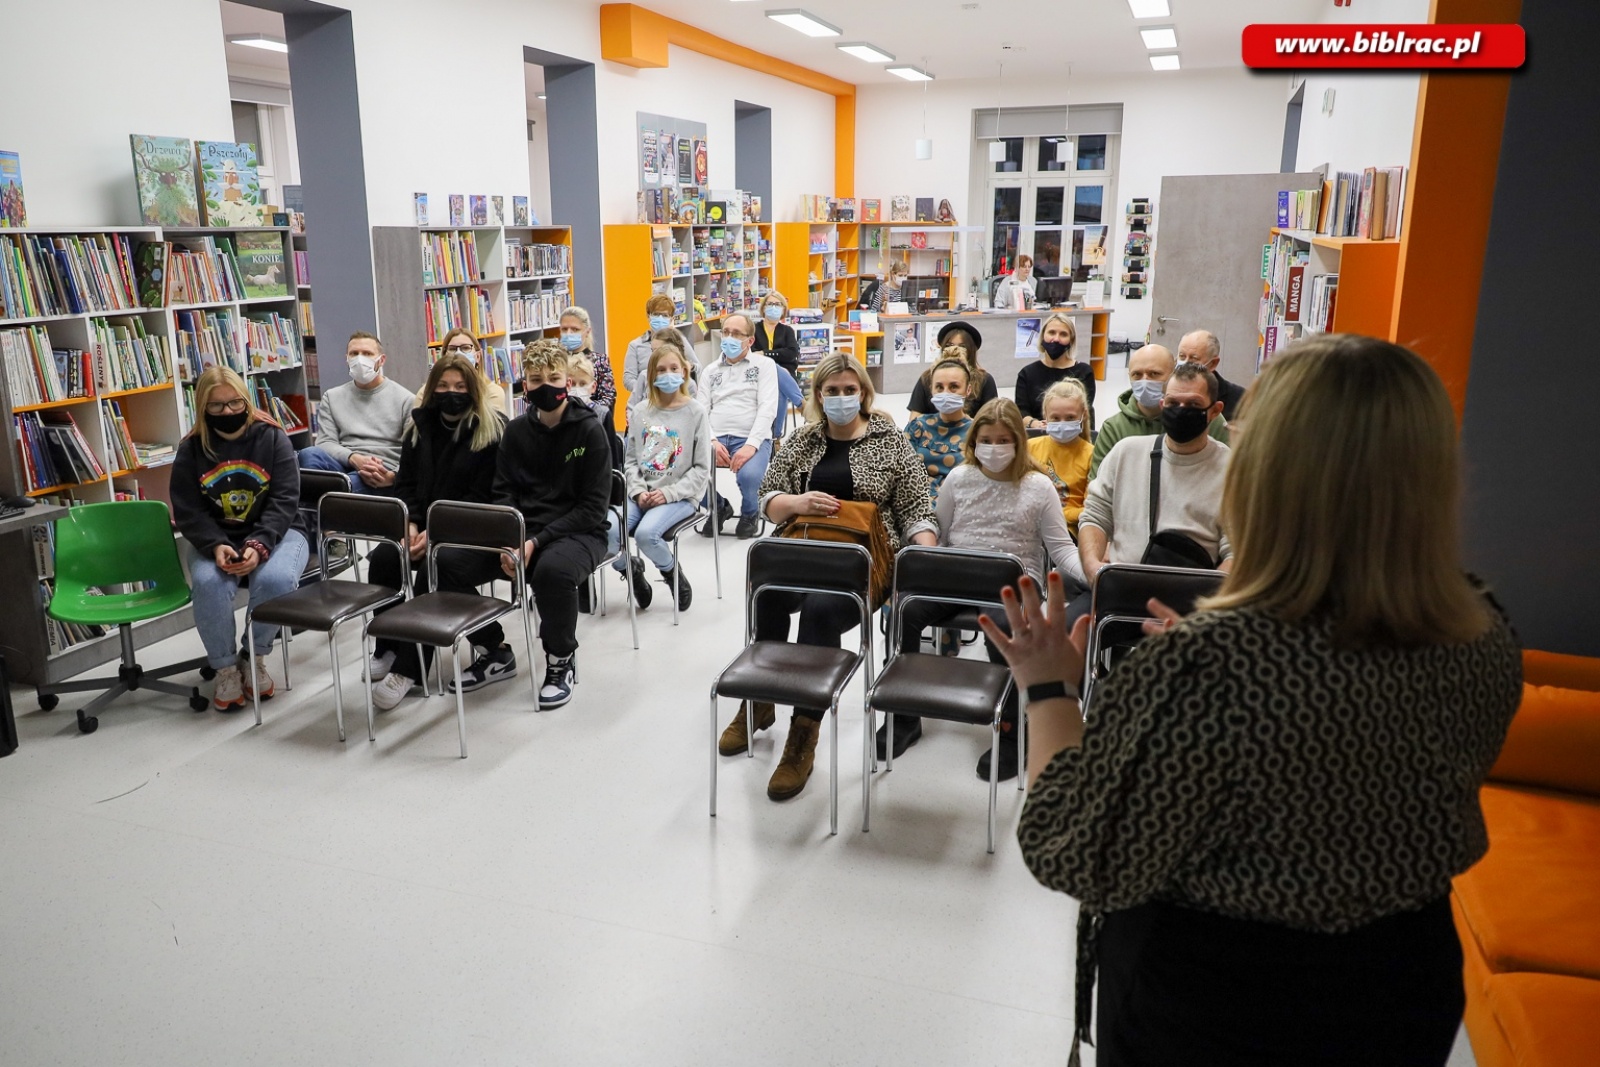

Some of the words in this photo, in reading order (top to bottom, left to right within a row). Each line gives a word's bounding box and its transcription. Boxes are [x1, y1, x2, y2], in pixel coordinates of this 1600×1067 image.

[144, 140, 182, 156] Drzewa
[208, 145, 248, 161] Pszczoły
[252, 254, 281, 264] KONIE
[1289, 275, 1301, 313] MANGA
[1267, 327, 1276, 354] ERZĘTA
[96, 344, 104, 381] ROŚLINY
